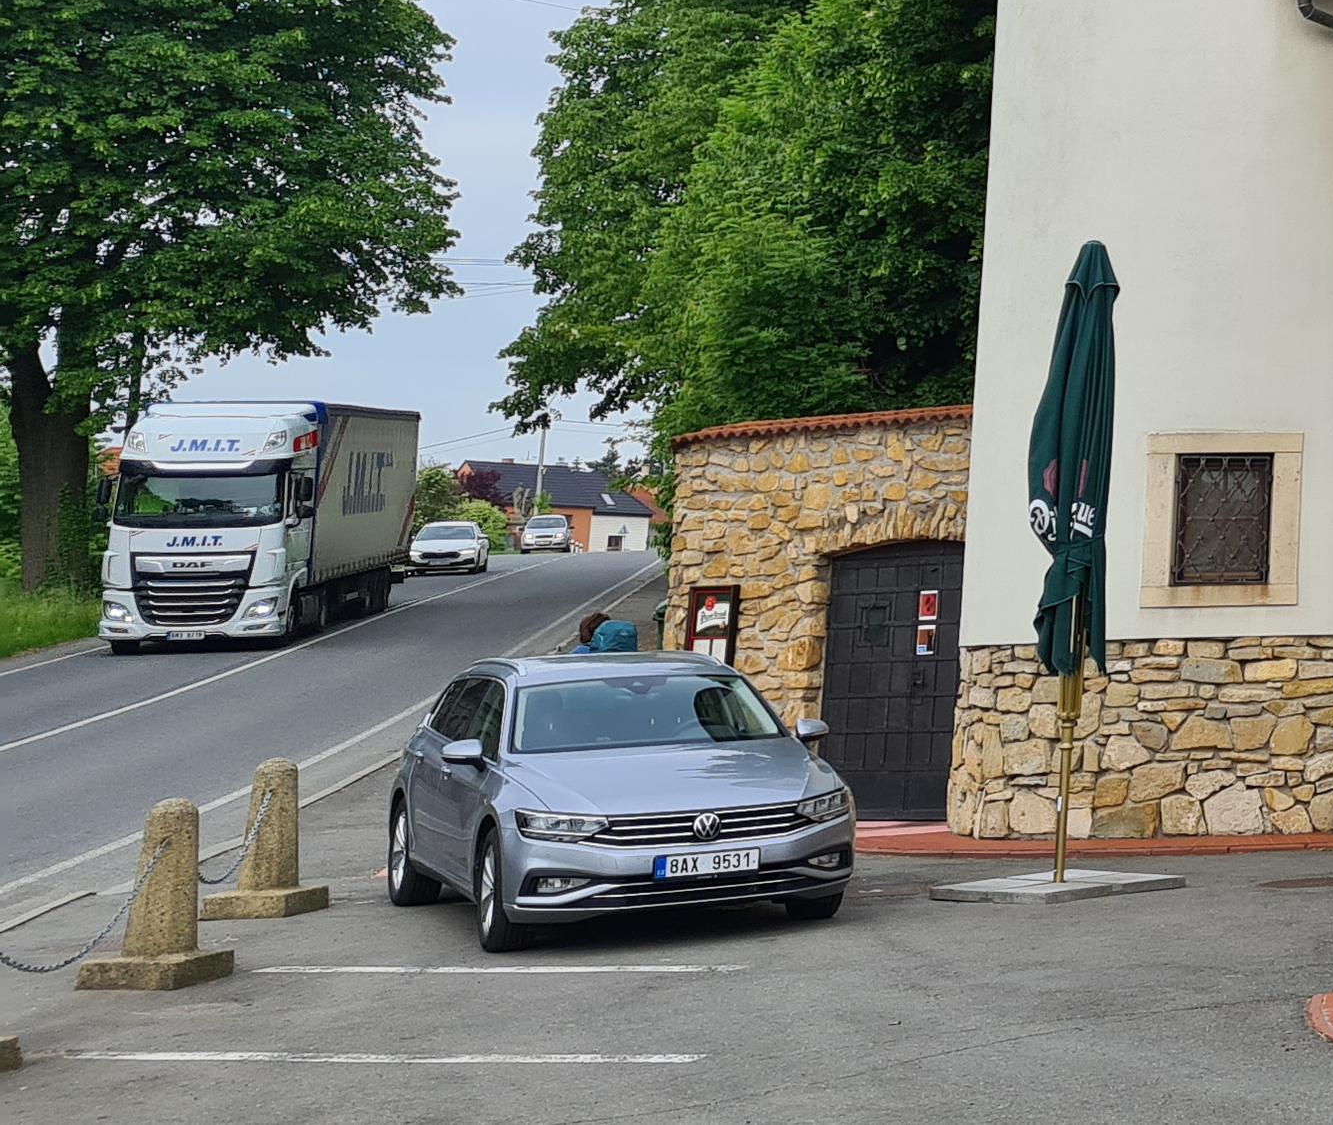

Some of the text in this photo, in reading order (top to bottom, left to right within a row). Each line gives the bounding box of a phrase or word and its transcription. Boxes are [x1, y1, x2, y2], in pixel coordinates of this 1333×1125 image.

[170, 439, 241, 452] J.M.I.T.
[166, 536, 222, 548] J.M.I.T.
[172, 561, 213, 569] DAF
[669, 852, 751, 874] 8AX 9531
